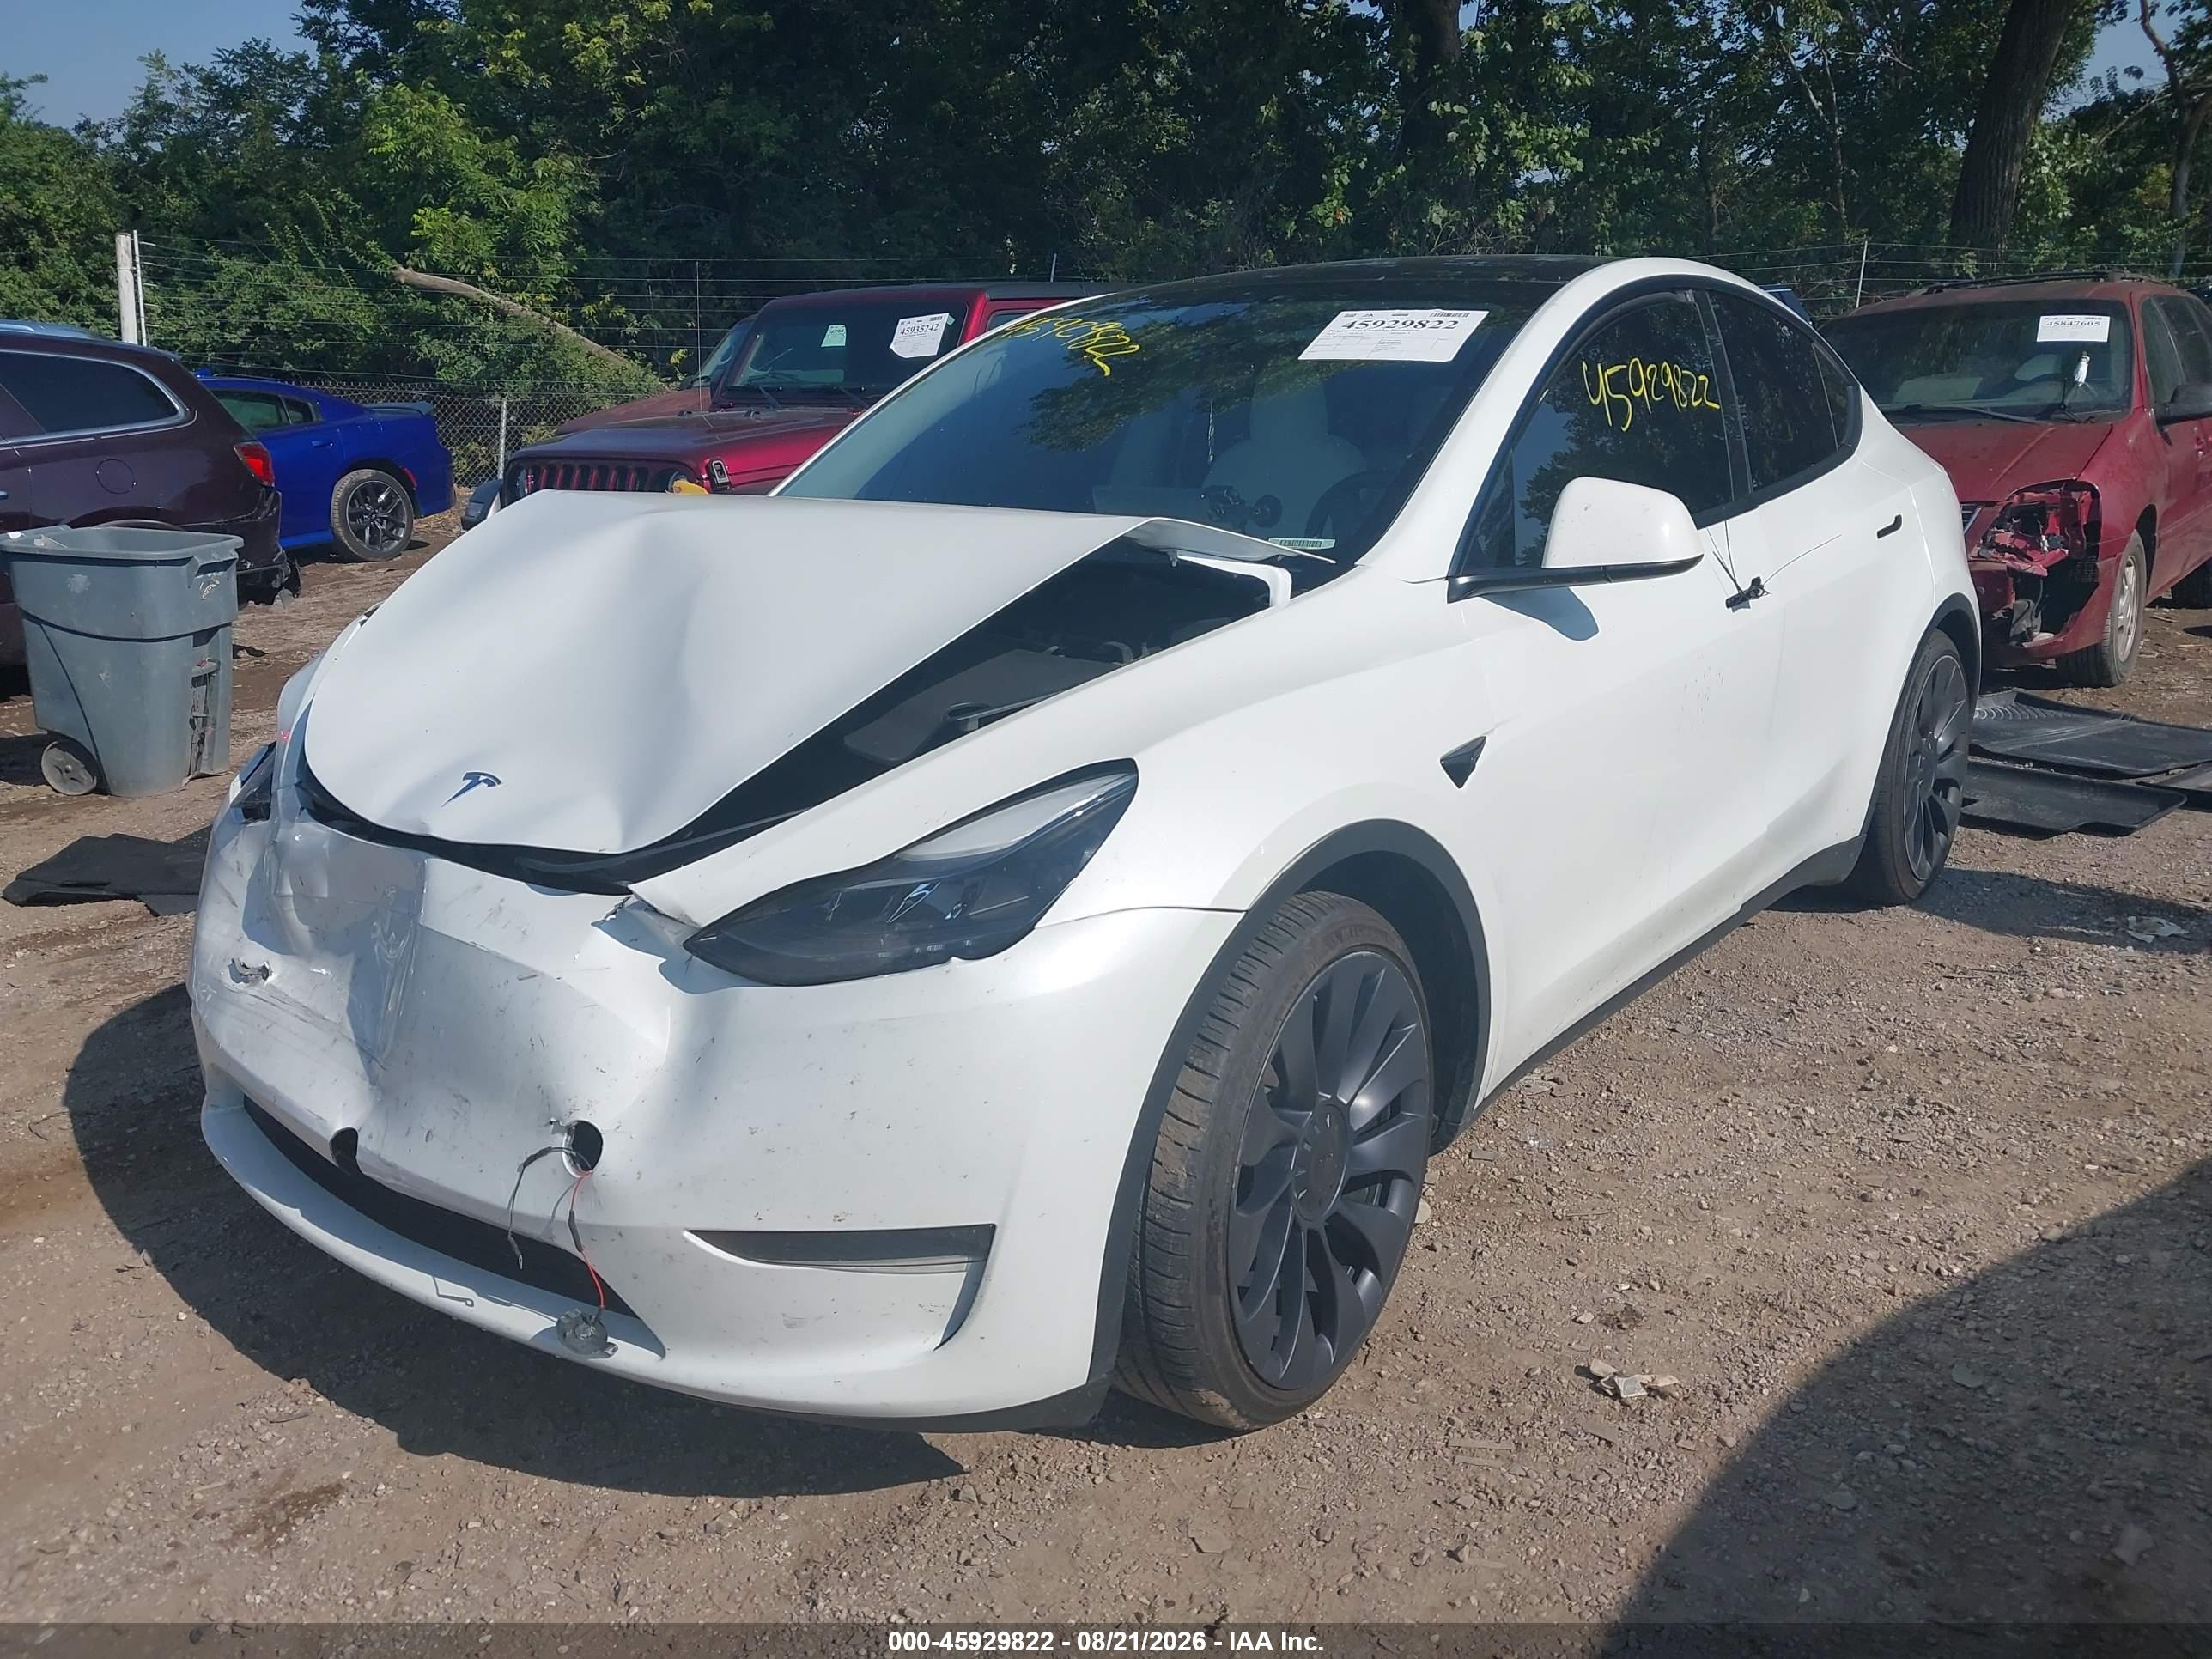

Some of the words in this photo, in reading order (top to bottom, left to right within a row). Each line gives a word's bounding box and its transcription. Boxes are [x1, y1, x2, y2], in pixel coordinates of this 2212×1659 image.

[900, 323, 939, 335] 45935242
[1341, 319, 1460, 330] 45929822
[1582, 357, 1720, 432] 45929822
